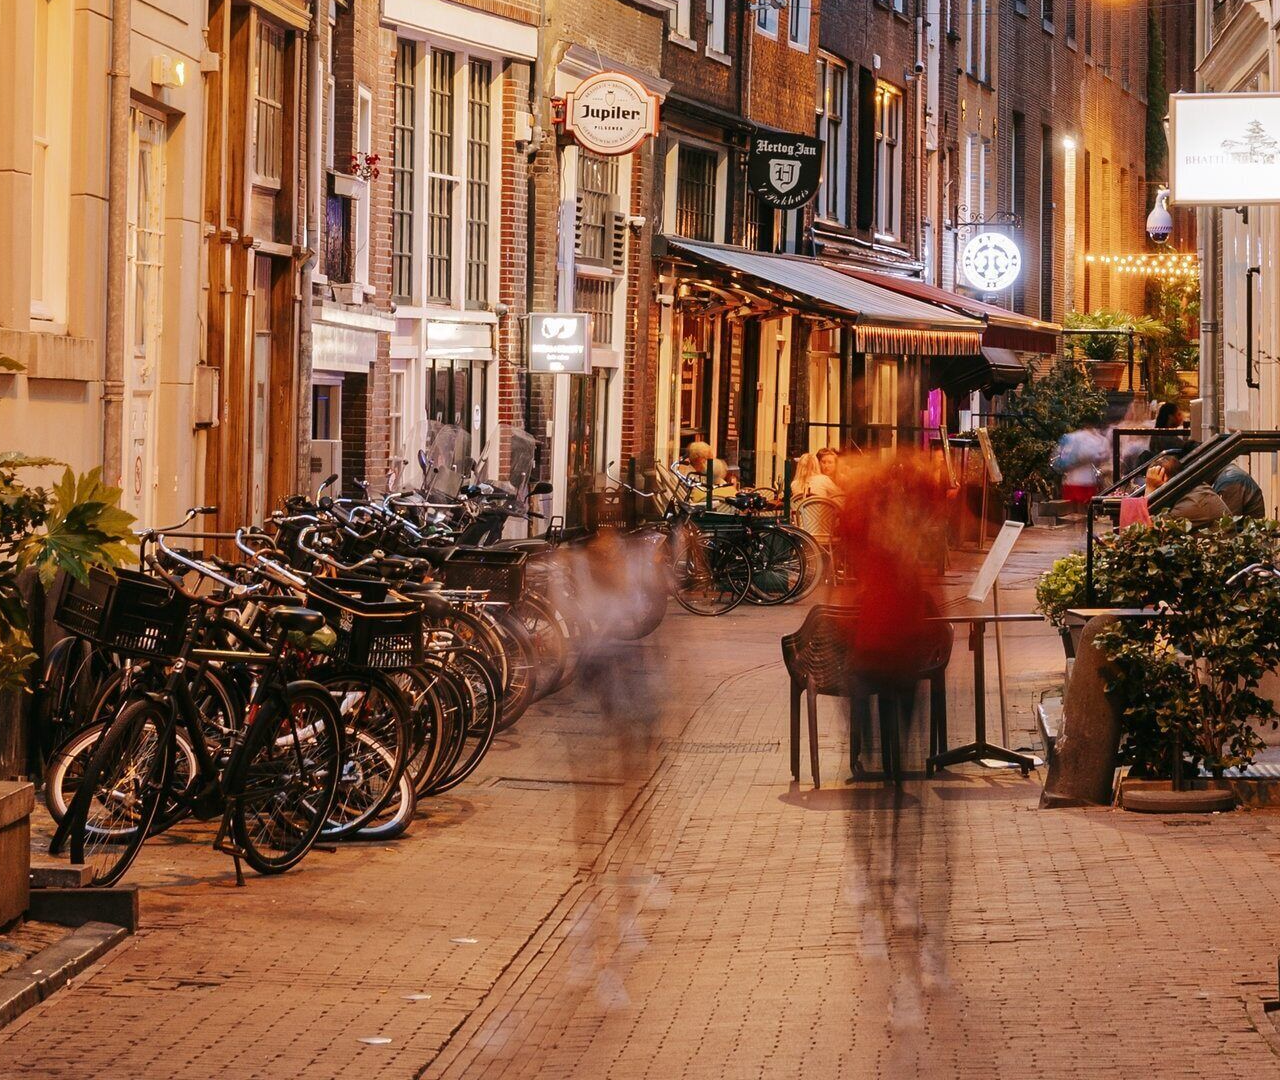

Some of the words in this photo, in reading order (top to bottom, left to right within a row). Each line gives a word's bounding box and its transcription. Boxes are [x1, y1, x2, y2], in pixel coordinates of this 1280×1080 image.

[581, 104, 640, 121] Jupiler
[756, 139, 795, 156] Hertog
[794, 142, 817, 158] Jan
